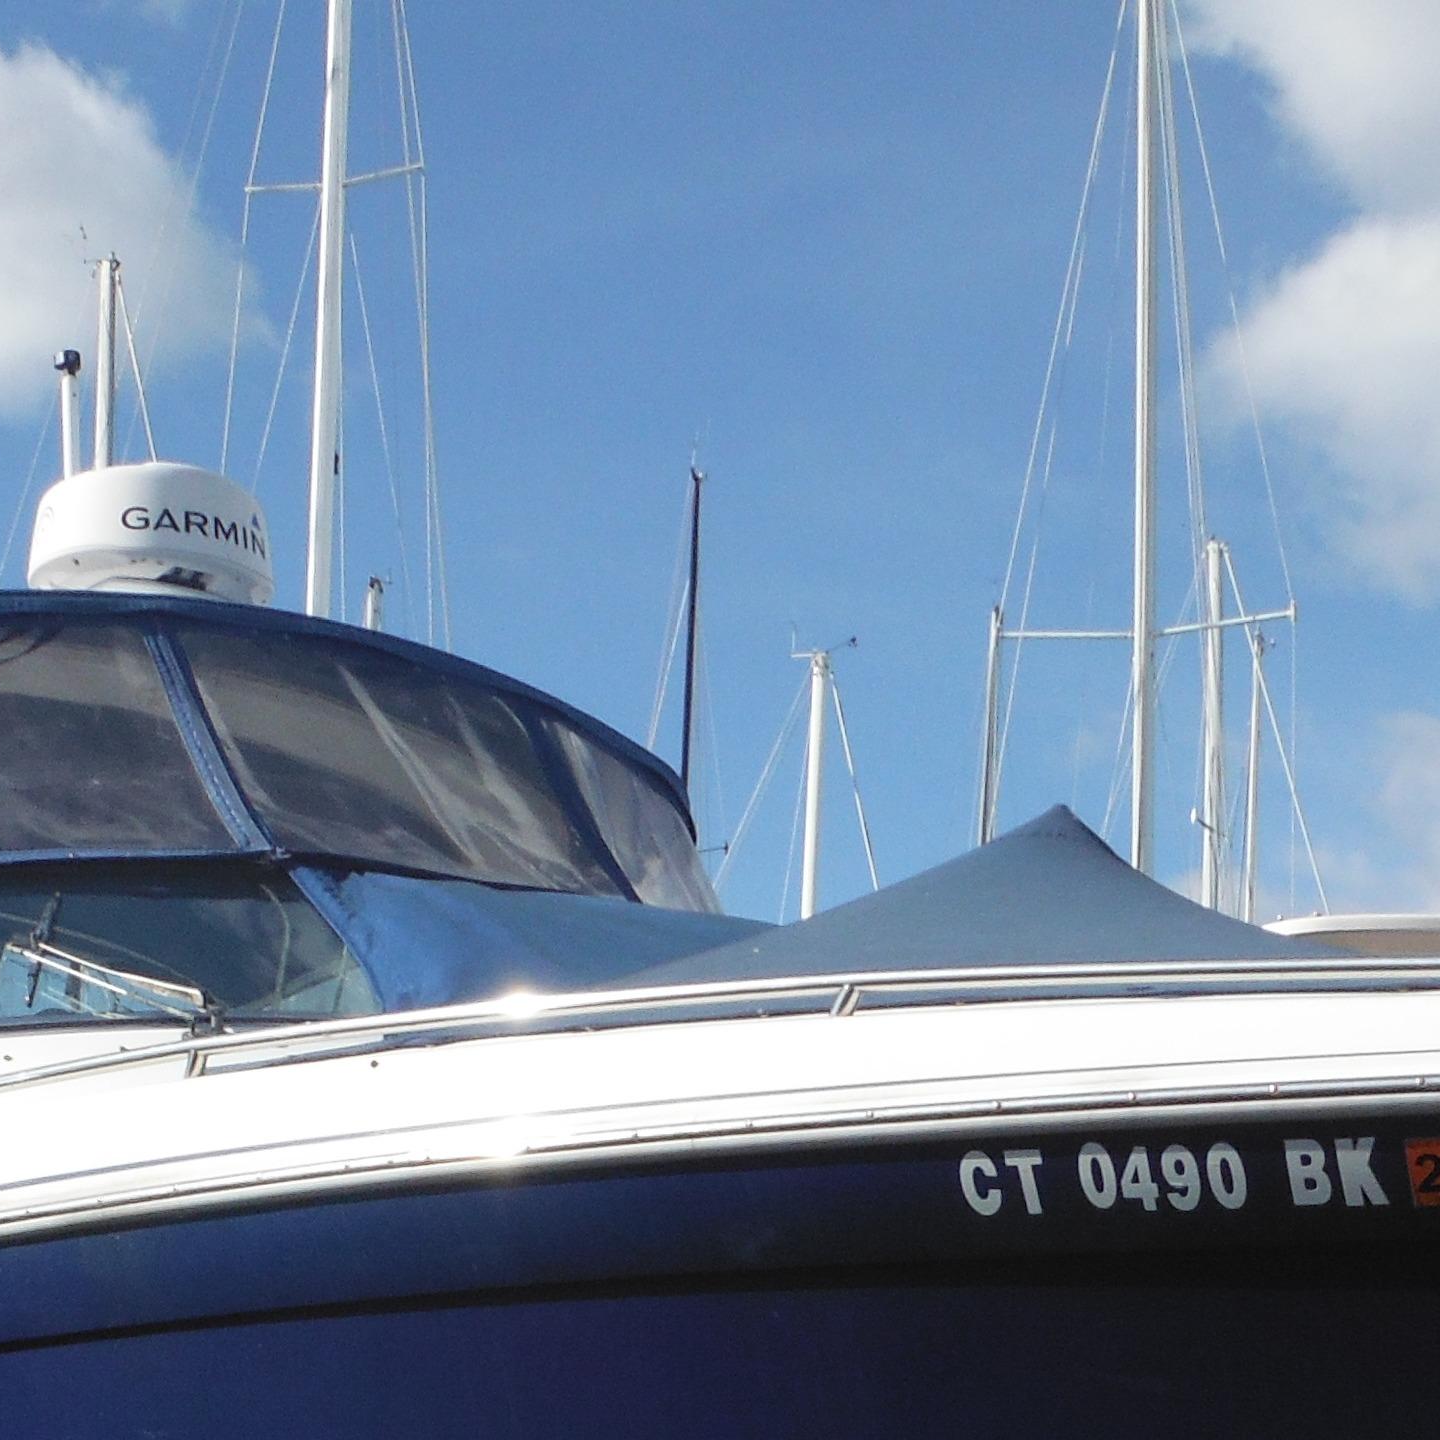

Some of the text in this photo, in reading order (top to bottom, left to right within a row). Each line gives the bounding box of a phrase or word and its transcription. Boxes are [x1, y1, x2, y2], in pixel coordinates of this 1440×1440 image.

[121, 506, 266, 560] GARMIN
[959, 1136, 1391, 1217] CT 0490 BK
